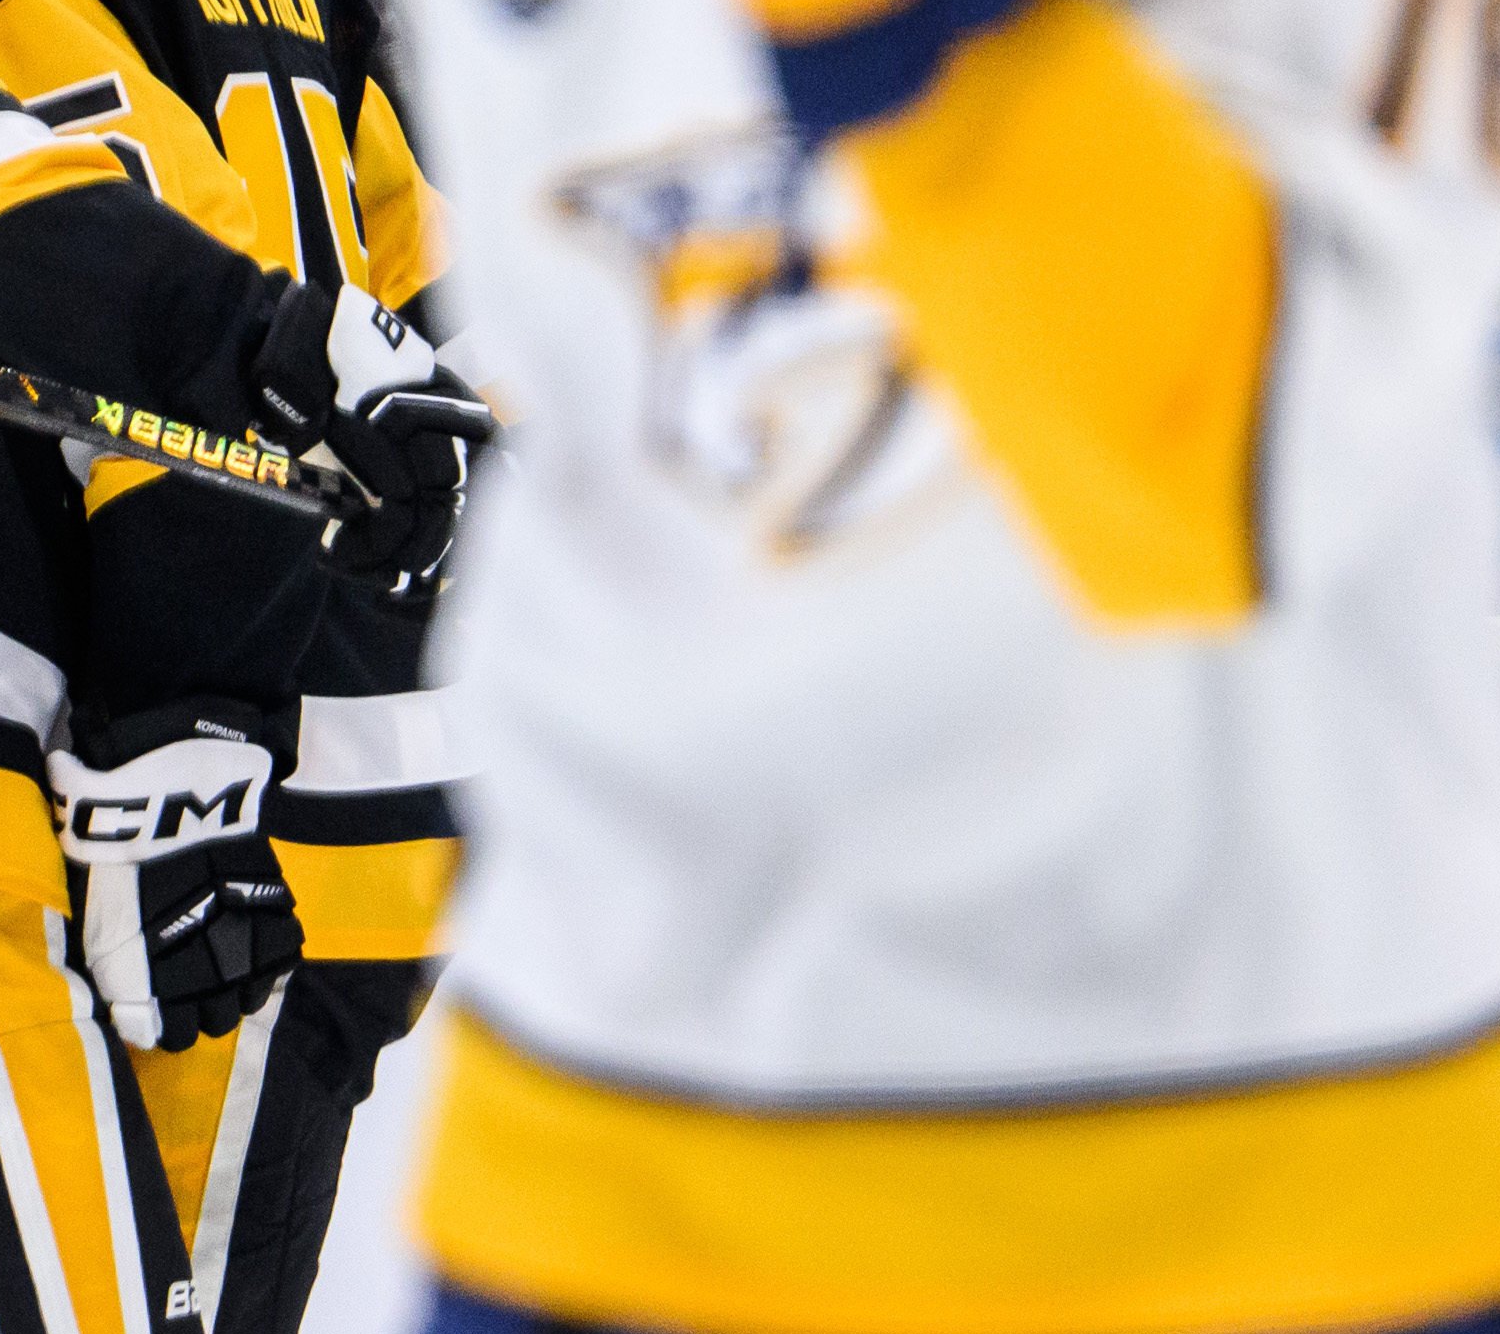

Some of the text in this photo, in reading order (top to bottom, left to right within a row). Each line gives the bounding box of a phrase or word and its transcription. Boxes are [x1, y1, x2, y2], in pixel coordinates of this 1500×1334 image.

[127, 409, 290, 490] BAUER
[194, 718, 248, 744] KOPPANEN
[51, 777, 254, 843] CM
